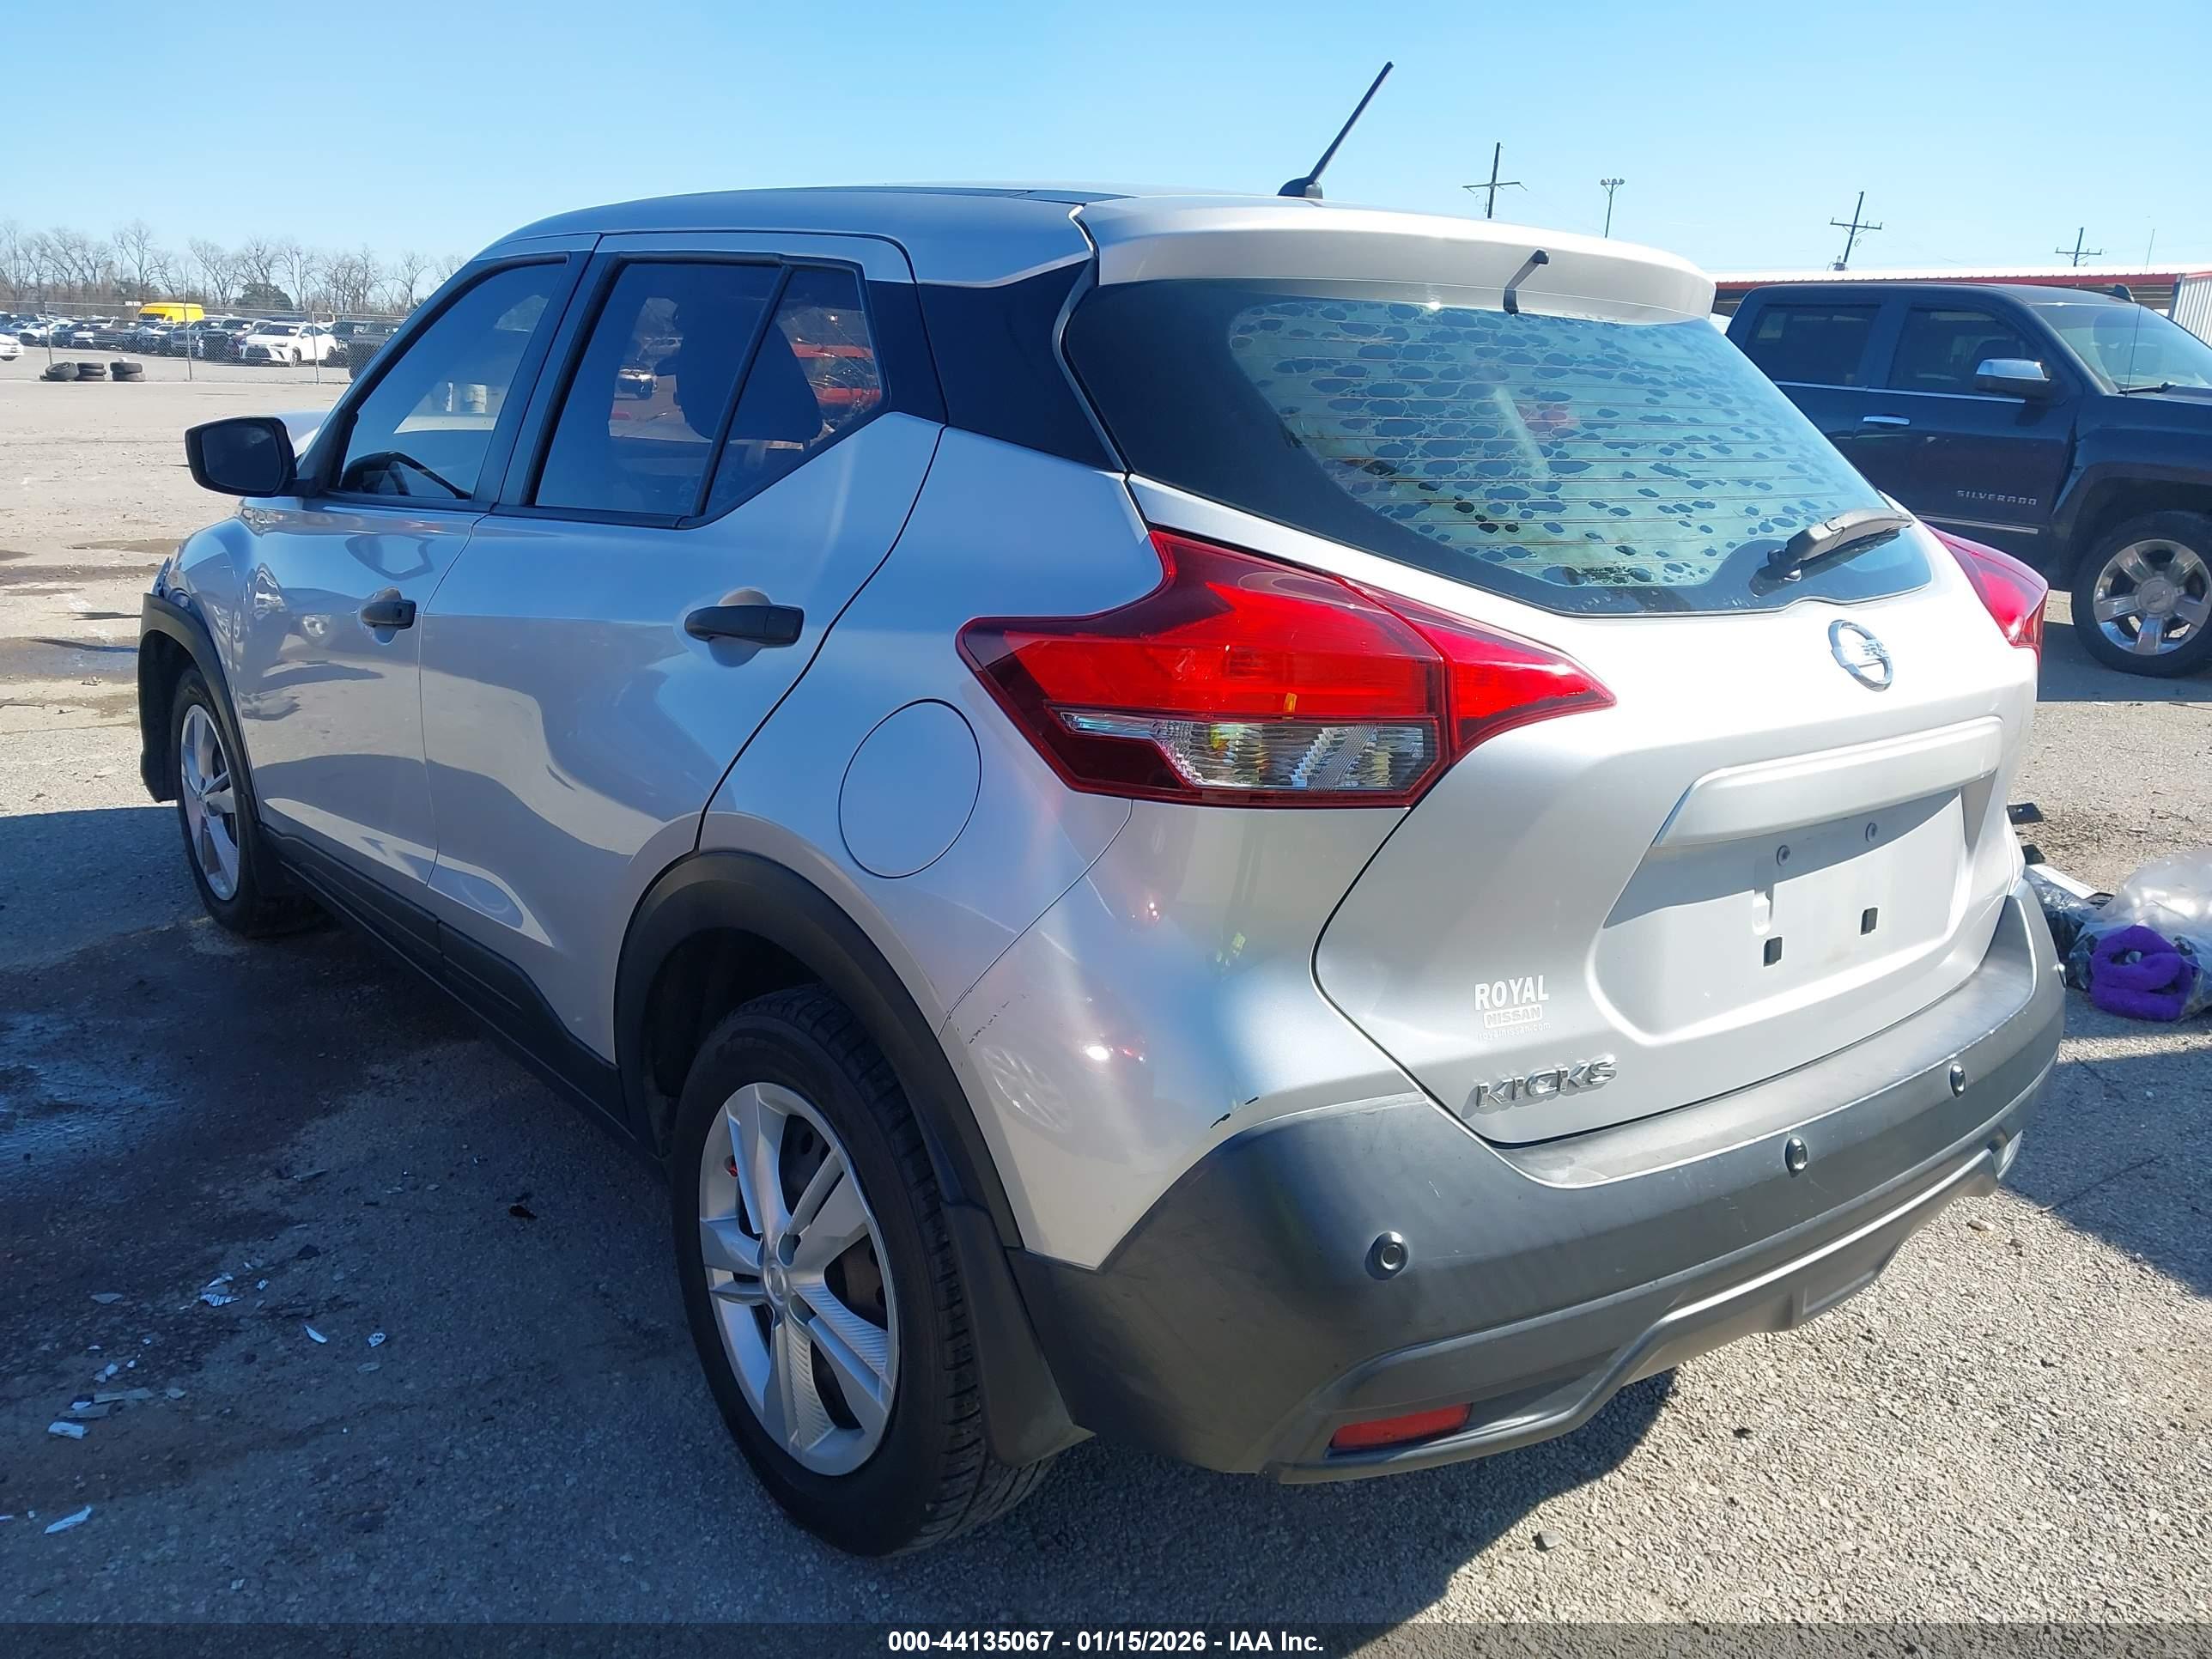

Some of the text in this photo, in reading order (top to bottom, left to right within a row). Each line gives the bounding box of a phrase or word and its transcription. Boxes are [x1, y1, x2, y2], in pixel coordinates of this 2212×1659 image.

[1957, 490, 2038, 506] SILVERADO
[1474, 975, 1550, 1011] ROYAL
[1486, 1006, 1542, 1026] NISSAN
[1475, 1059, 1618, 1108] KICKS
